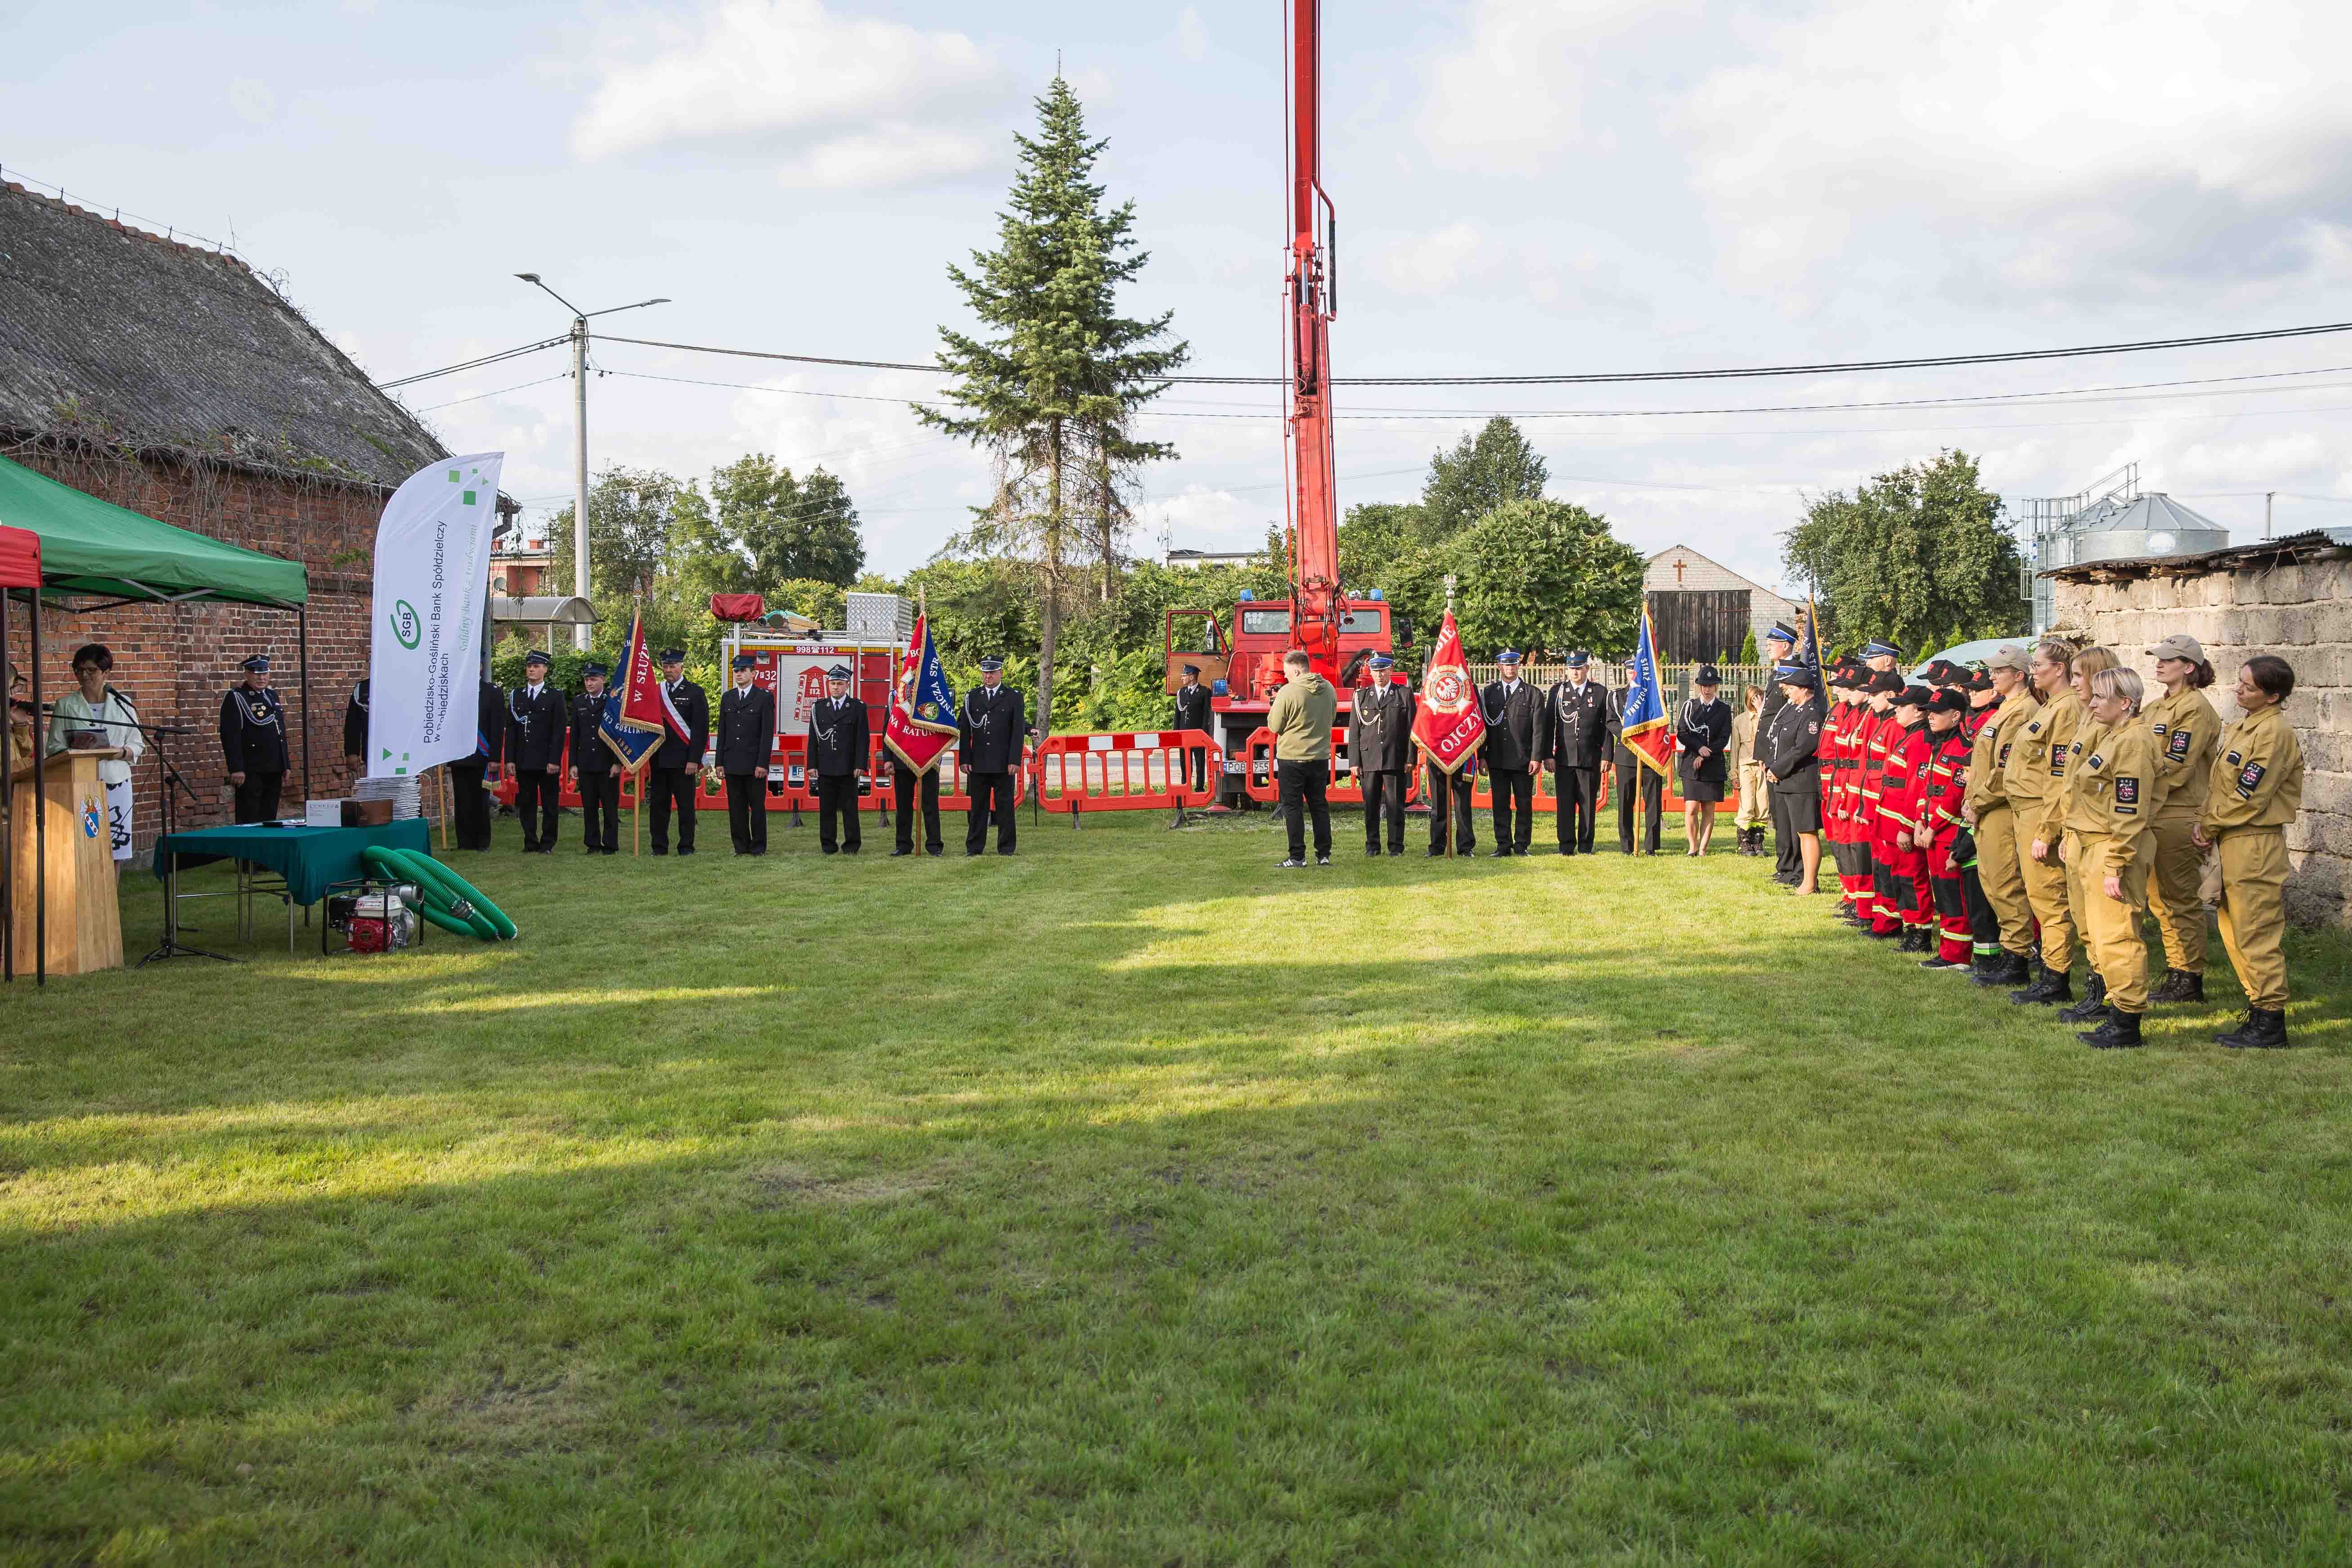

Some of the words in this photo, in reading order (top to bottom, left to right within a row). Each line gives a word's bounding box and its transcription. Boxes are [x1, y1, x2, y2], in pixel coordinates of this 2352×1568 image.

[432, 521, 447, 589] Spółdzielczy
[431, 593, 442, 620] Bank
[402, 612, 412, 638] SGB
[1640, 658, 1651, 681] STRAŻ
[423, 624, 440, 743] Pobiedzisko-Gośliński
[633, 690, 644, 702] W
[1625, 687, 1648, 717] POŻARNA
[434, 734, 440, 742] w
[1441, 705, 1482, 752] OJCZY
[1228, 763, 1246, 771] POB
